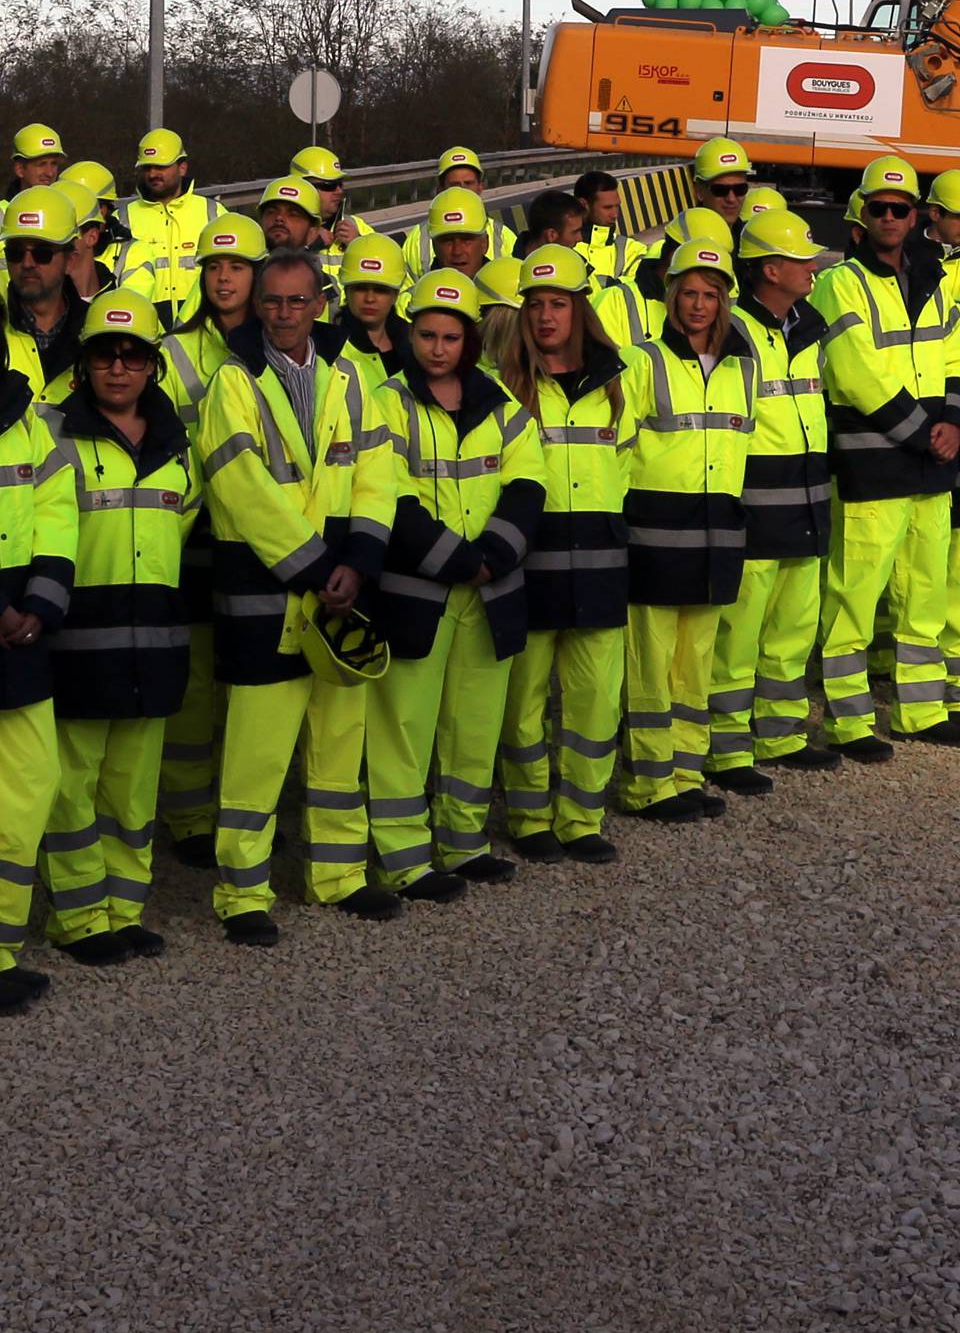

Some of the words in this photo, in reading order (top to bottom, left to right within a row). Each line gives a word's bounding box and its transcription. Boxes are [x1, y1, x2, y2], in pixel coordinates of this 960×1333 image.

[638, 64, 678, 79] ISKOP
[812, 79, 852, 88] BOUYGUES
[784, 110, 828, 118] PODRUŽNICA
[605, 113, 683, 136] 954
